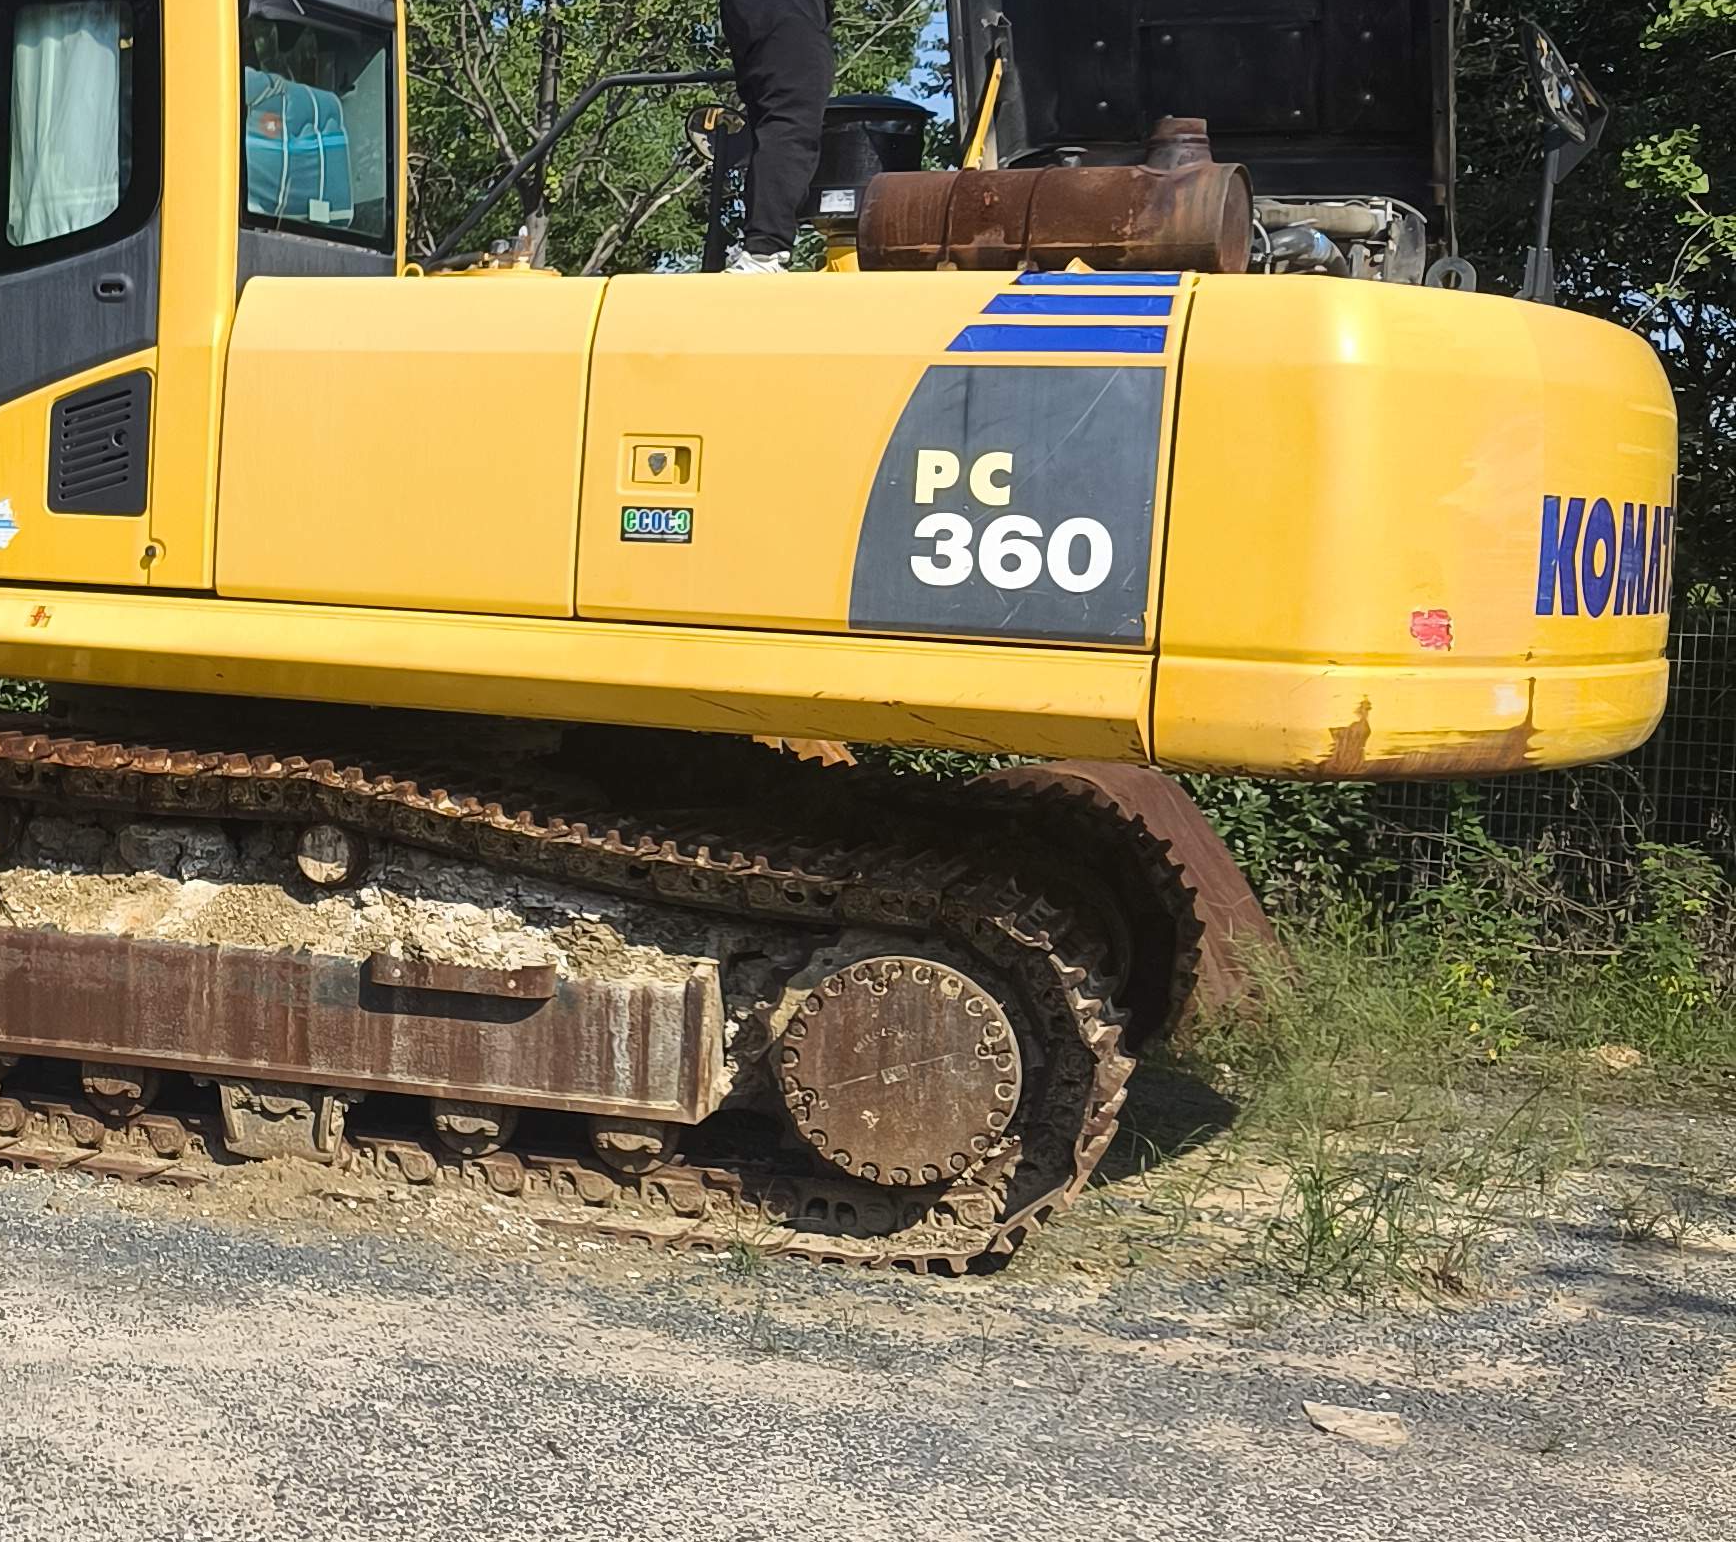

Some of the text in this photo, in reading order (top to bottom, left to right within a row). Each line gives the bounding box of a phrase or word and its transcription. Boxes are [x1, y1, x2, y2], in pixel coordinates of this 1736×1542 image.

[914, 449, 1013, 506] PC
[624, 508, 691, 534] ecot3
[910, 512, 1113, 593] 360
